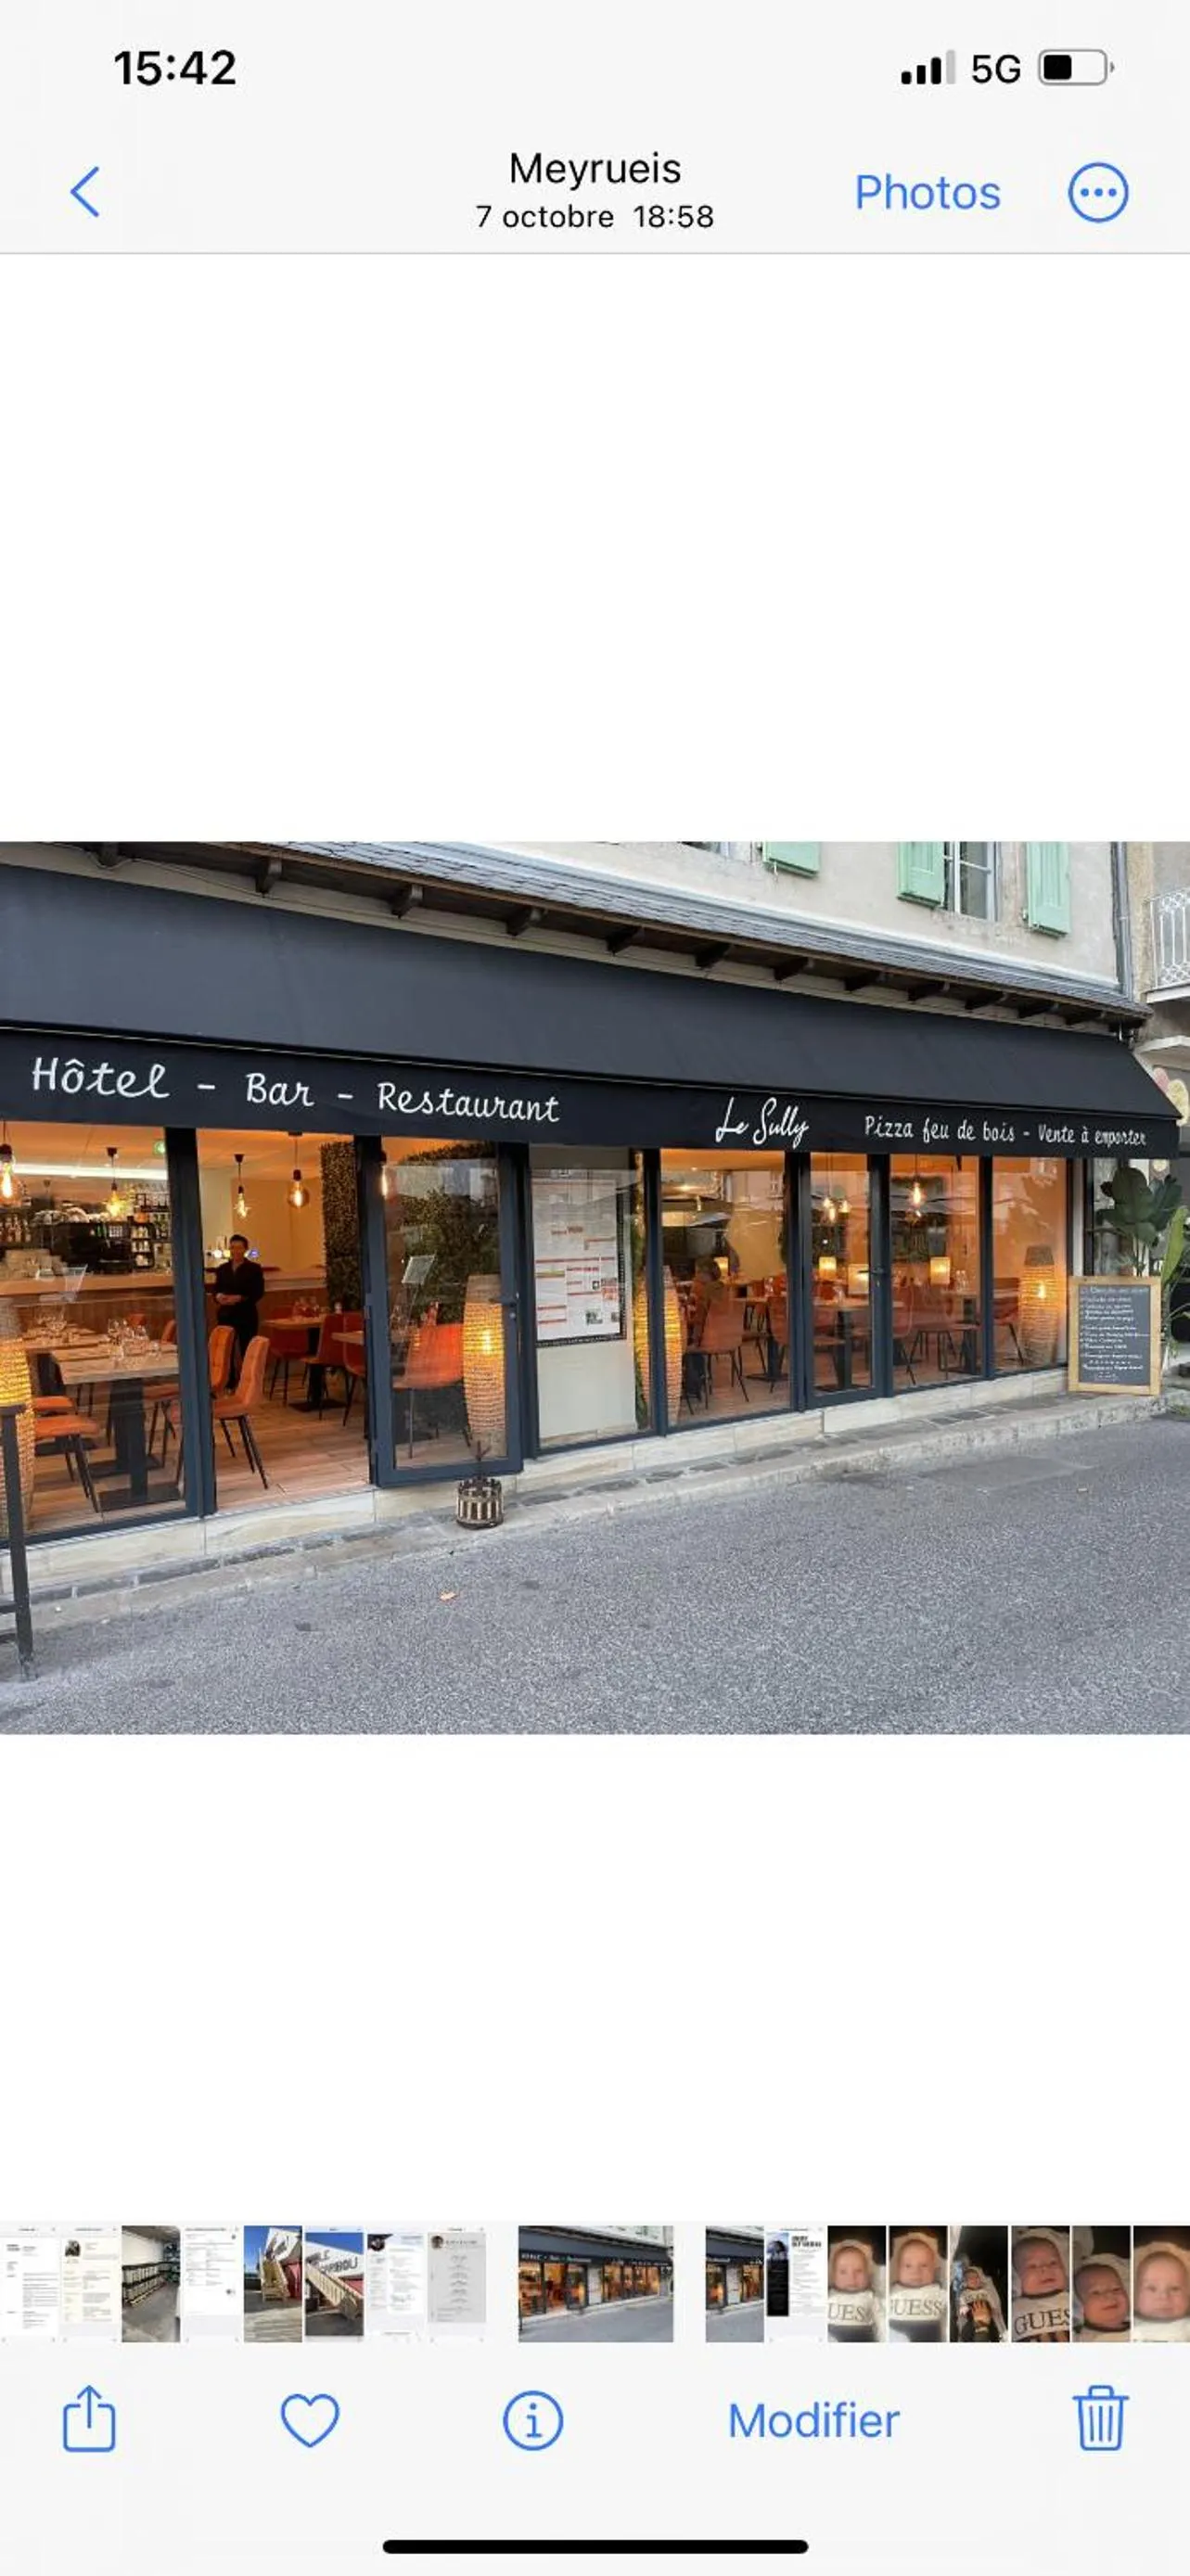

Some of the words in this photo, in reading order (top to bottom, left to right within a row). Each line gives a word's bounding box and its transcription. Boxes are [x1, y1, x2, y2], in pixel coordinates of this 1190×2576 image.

[114, 49, 237, 86] 15:42
[971, 54, 1021, 84] 5G
[510, 150, 682, 192] Meyrueis
[856, 172, 1001, 210] Photos
[476, 205, 493, 228] 7
[502, 203, 614, 229] octobre
[633, 204, 714, 229] 18:58
[32, 1056, 170, 1099] Hôtel
[246, 1072, 314, 1107] Bar
[377, 1081, 560, 1123] Restaurant
[715, 1096, 749, 1142] Le
[752, 1096, 810, 1148] Sully
[864, 1116, 914, 1138] Pizza
[922, 1116, 950, 1143] feu
[957, 1119, 977, 1141] de
[982, 1121, 1015, 1142] bois
[1038, 1124, 1076, 1143] Vente
[1081, 1126, 1090, 1143] à
[729, 2402, 899, 2439] Modifier
